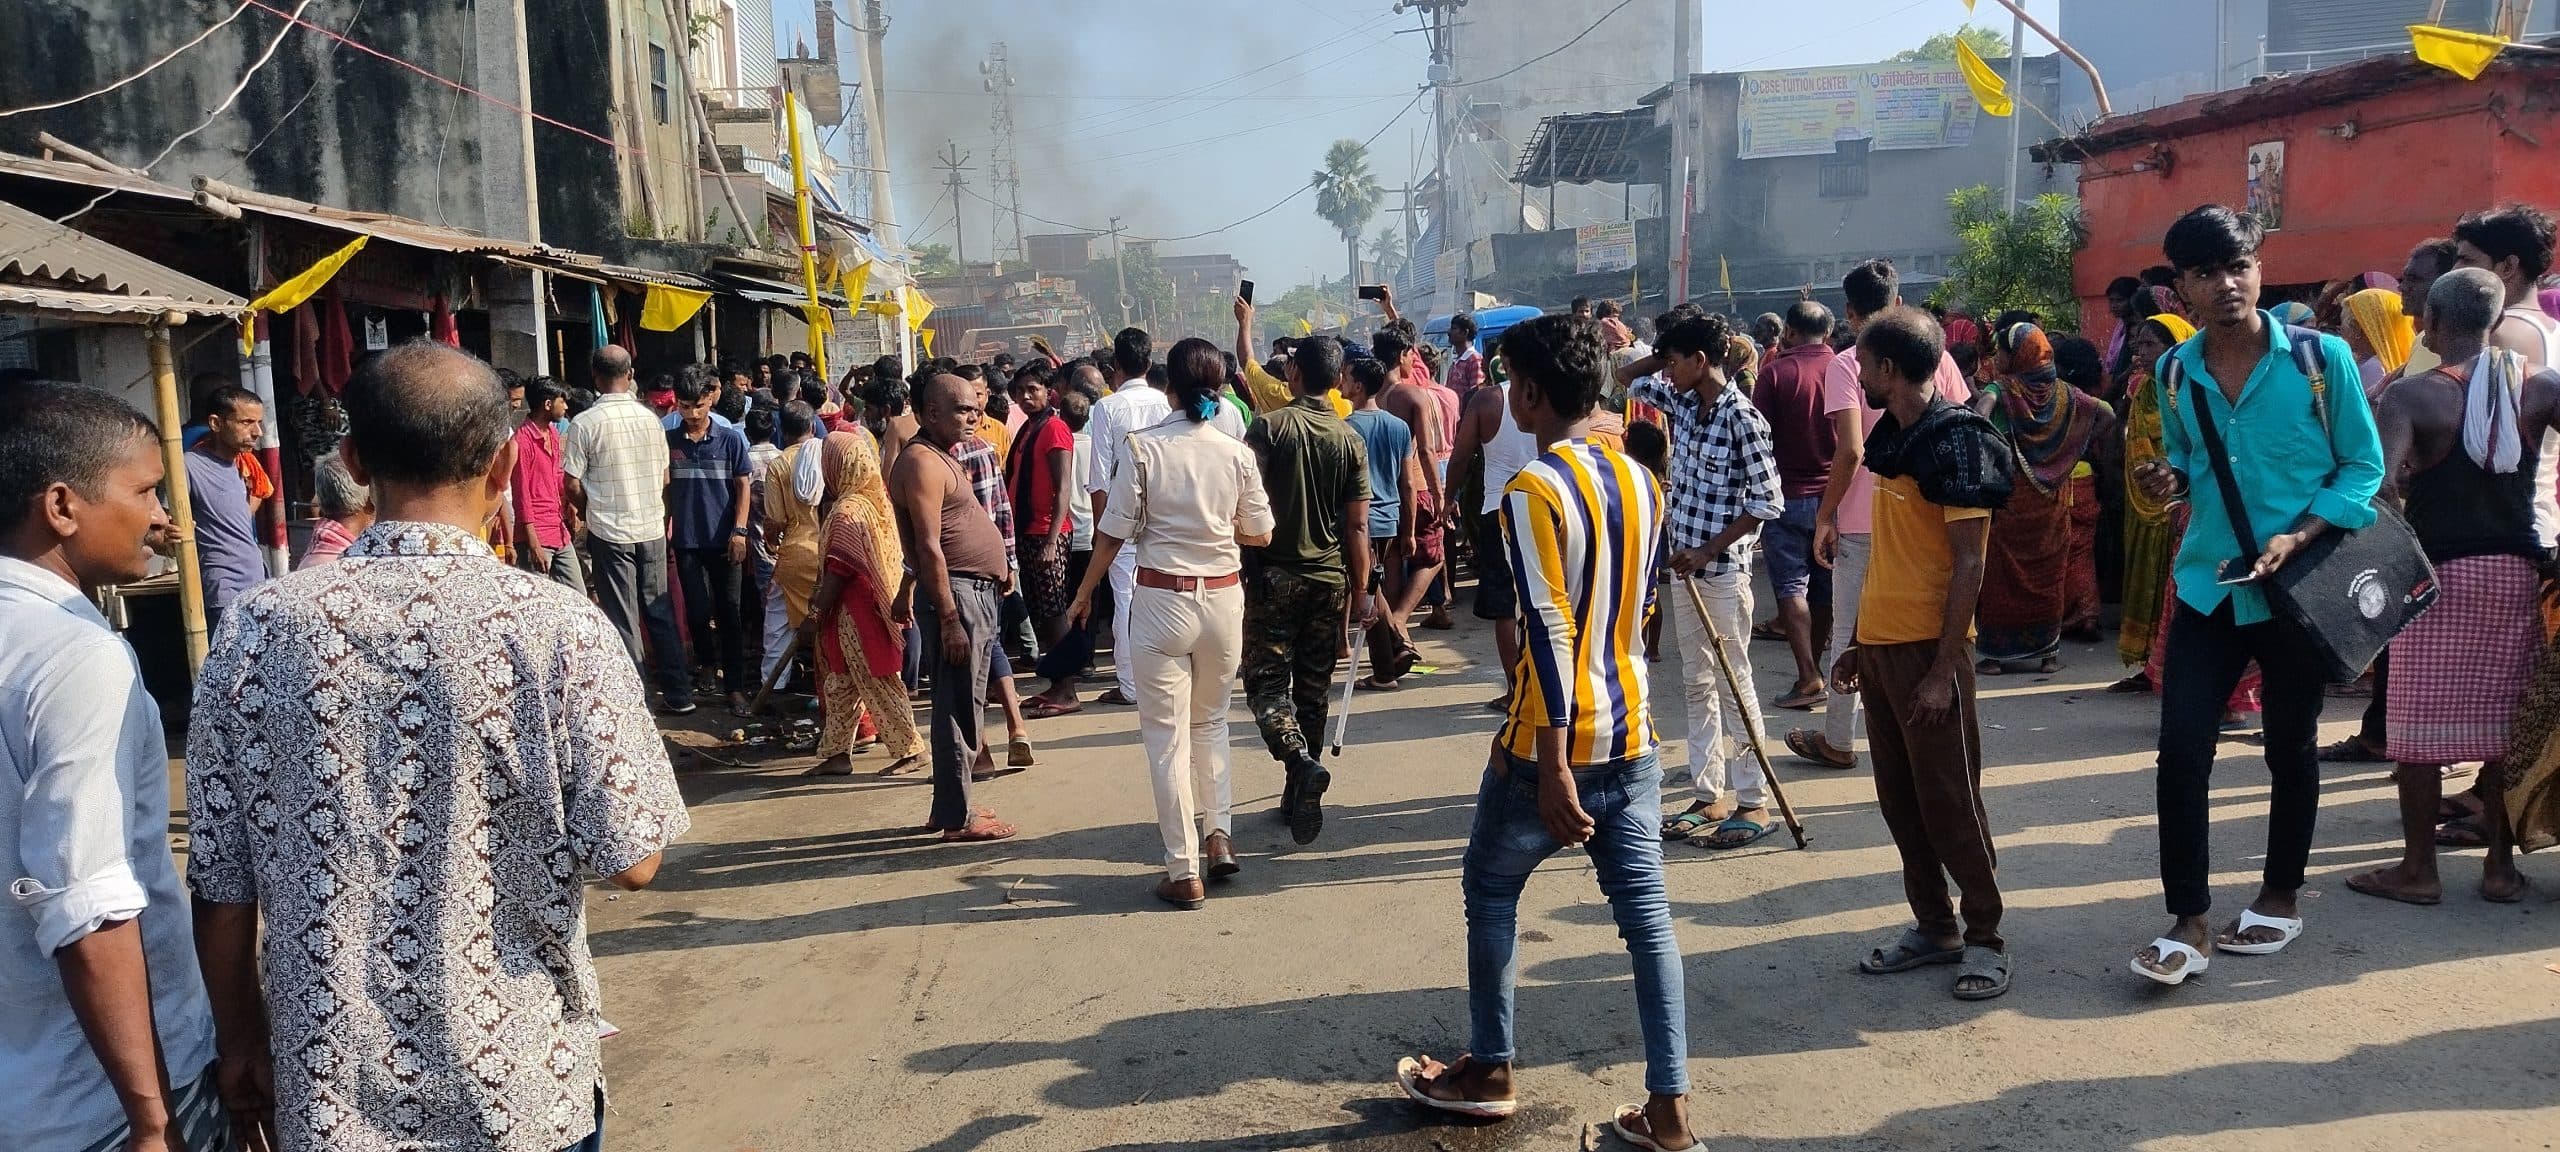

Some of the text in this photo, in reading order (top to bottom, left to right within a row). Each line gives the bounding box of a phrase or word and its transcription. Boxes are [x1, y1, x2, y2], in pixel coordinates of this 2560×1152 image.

[1760, 75, 1848, 94] CBSE TUITION CENTER
